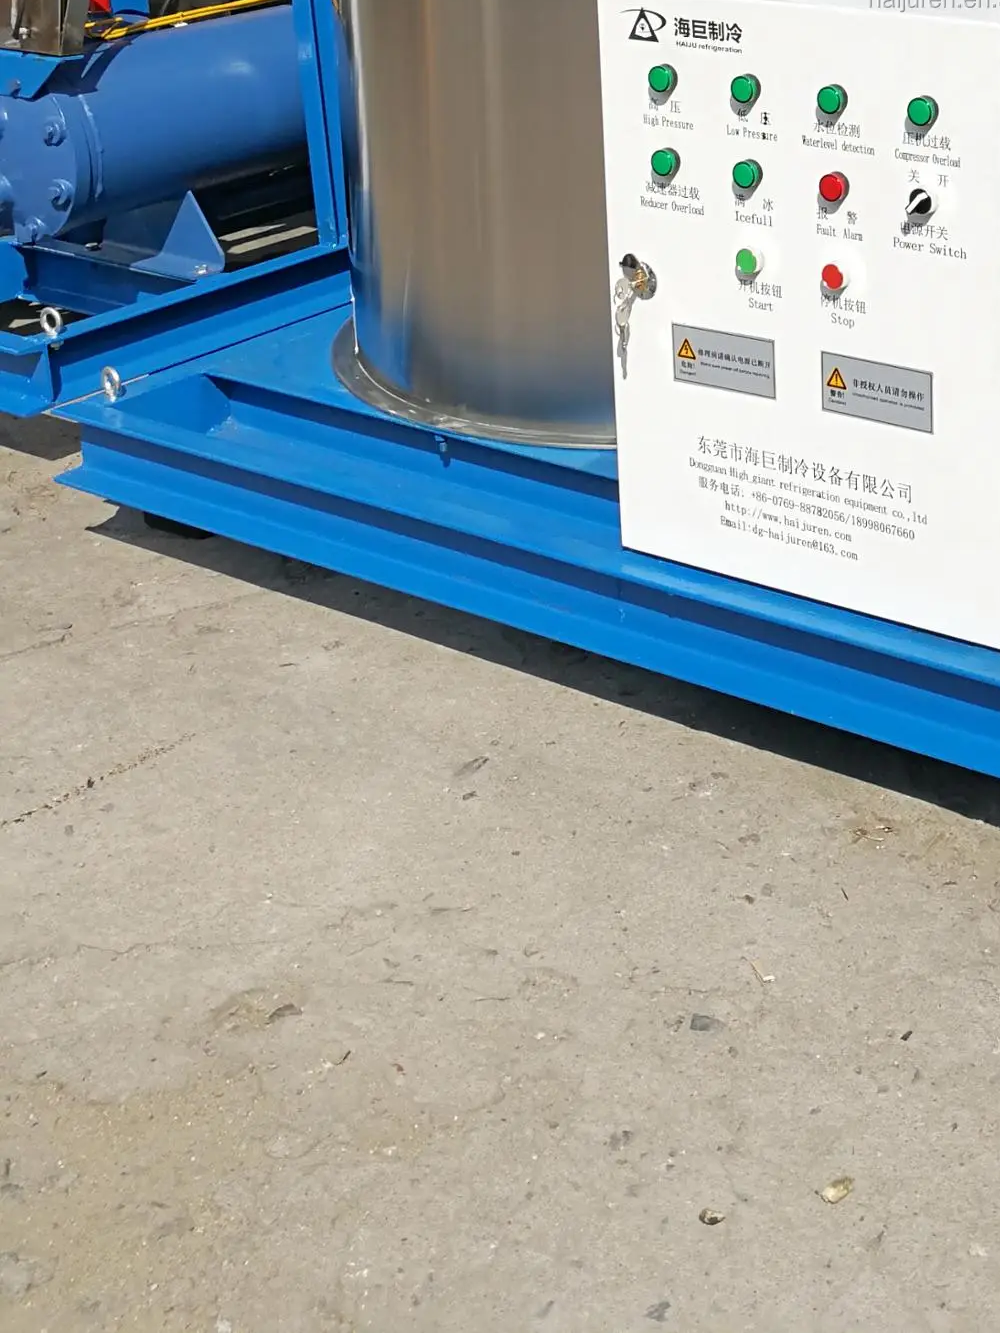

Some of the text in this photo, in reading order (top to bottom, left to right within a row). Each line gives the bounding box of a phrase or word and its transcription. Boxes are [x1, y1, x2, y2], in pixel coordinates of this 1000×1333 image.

[674, 17, 743, 44] 海巨制冷
[676, 41, 743, 55] HAIJU refrigeration
[643, 114, 694, 131] High Pressure
[813, 119, 861, 139] 水位检测
[726, 124, 778, 142] Low Pressure
[902, 131, 952, 151] 压机过载
[801, 134, 875, 157] Waterlevel detection
[894, 149, 961, 168] Compressor Overload
[908, 168, 949, 188] 关 开
[640, 196, 704, 216] Reducer Overload
[735, 210, 773, 227] Icefull
[816, 223, 863, 242] Fault Alarm
[900, 221, 949, 241] 电源开关
[893, 236, 967, 260] Power Switch
[738, 278, 782, 299] 开机按钮
[748, 297, 773, 312] Start
[830, 312, 855, 329] Stop
[852, 378, 925, 403] 非授权人员请勿操作
[697, 435, 912, 504] 东莞市海巨制冷设备有限公司
[689, 456, 727, 476] Dongguan
[779, 480, 840, 504] refrigeration
[844, 496, 887, 515] equipment
[698, 475, 915, 540] 服务电话: +86-0769-88782056/18998067660
[724, 499, 852, 542] http://www.haijuren.com
